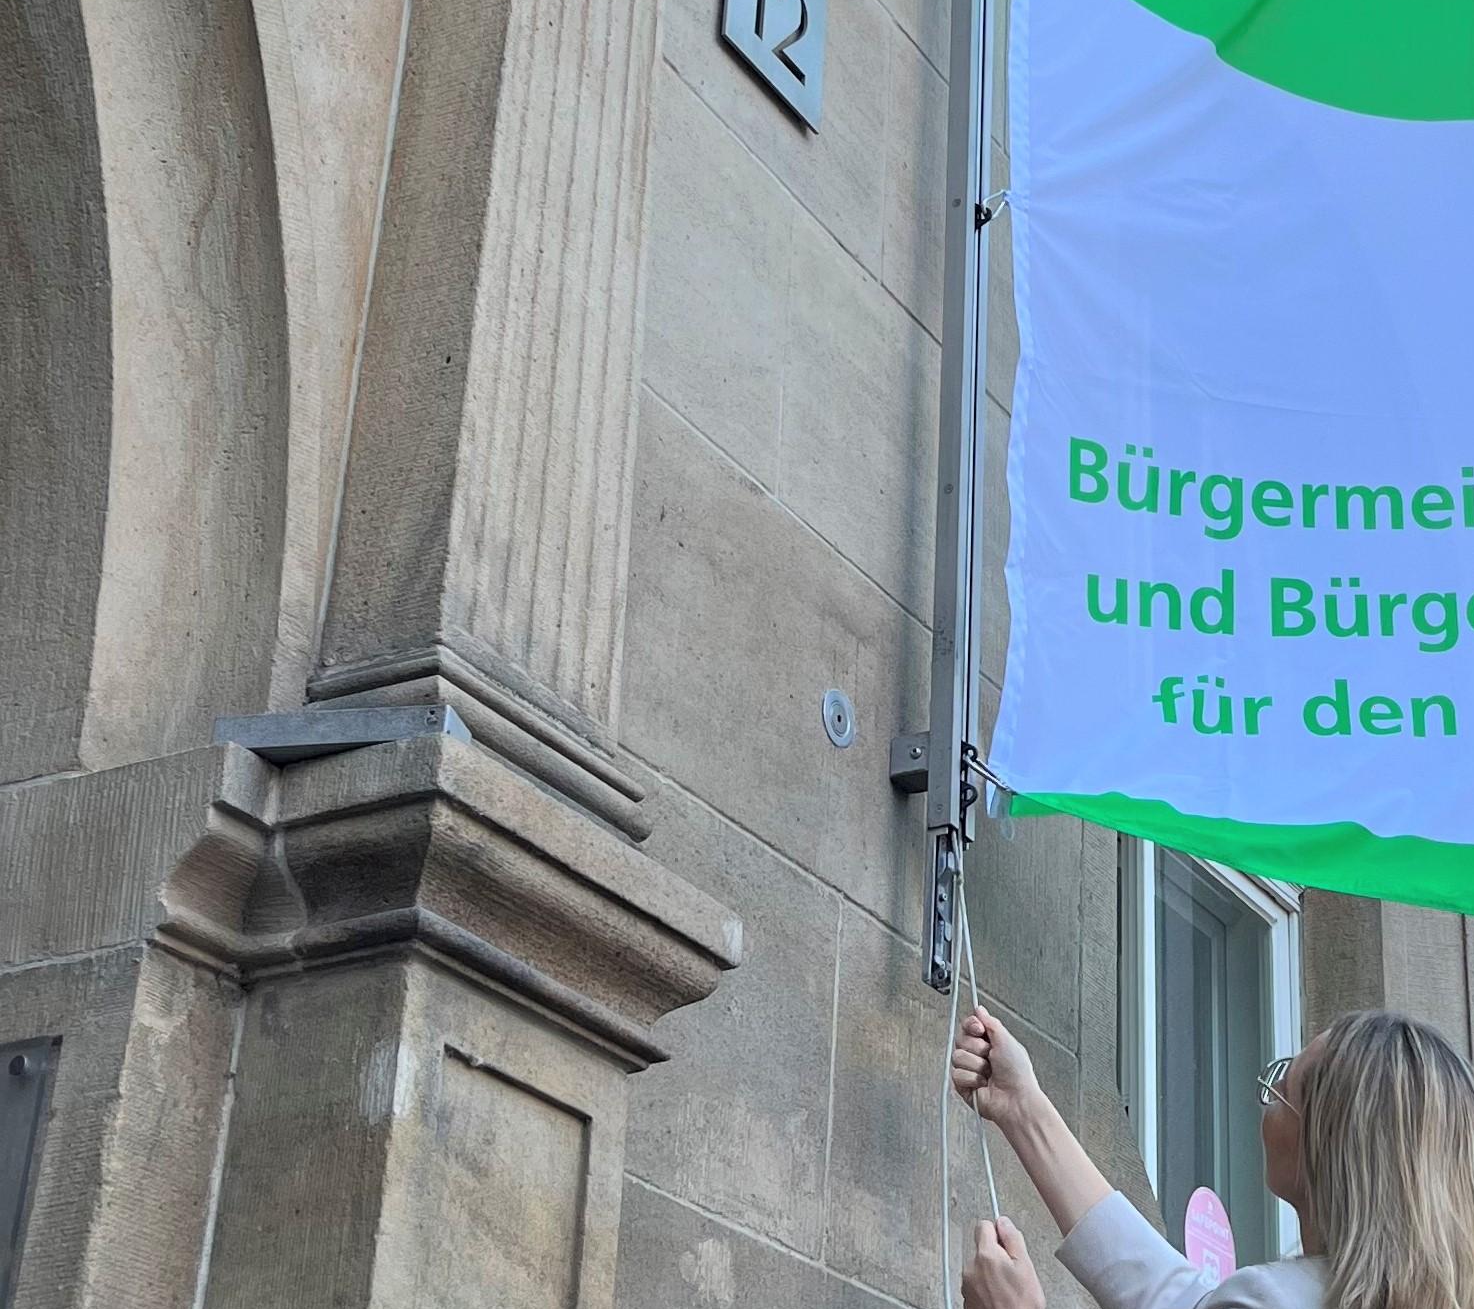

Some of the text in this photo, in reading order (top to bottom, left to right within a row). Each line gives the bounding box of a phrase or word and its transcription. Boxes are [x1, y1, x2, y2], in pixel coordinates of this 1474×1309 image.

[1086, 569, 1235, 636] und
[1151, 674, 1273, 736] für
[1303, 678, 1457, 738] den
